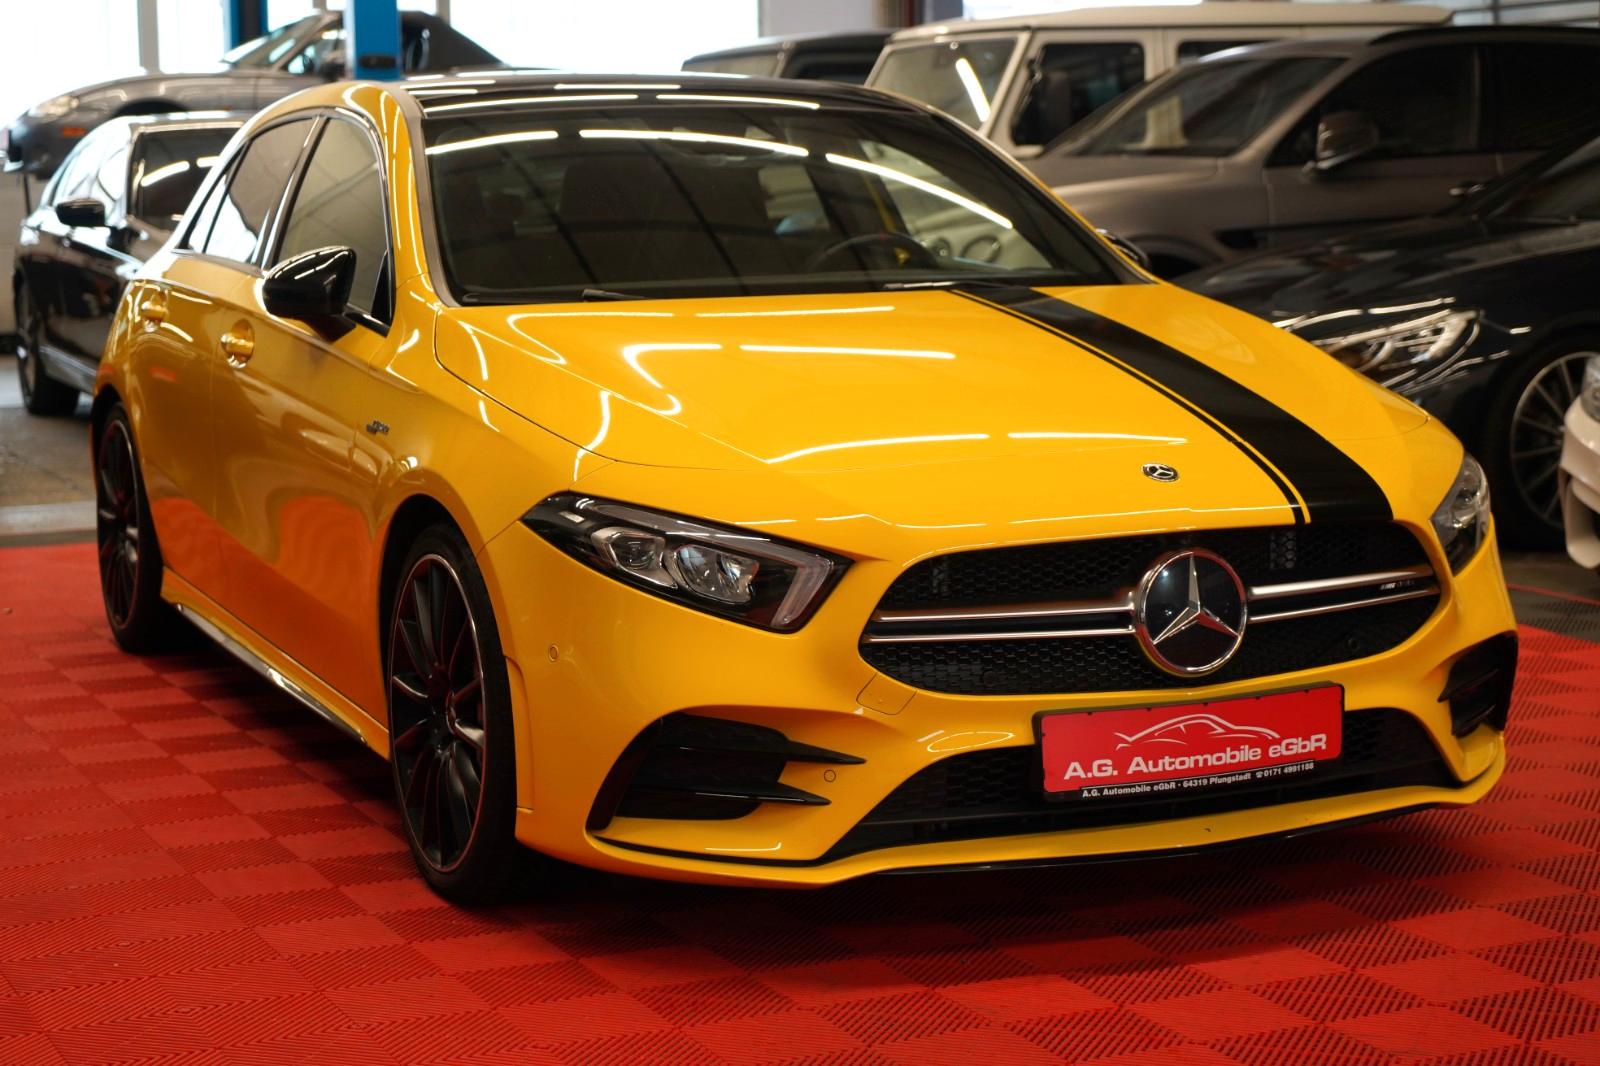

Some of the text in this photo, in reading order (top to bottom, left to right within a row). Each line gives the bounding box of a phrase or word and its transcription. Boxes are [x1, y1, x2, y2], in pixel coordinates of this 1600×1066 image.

[1064, 733, 1327, 780] A.G. Automobile eGbR
[1082, 788, 1101, 798] A.G.
[1103, 783, 1151, 796] Automobile
[1153, 783, 1176, 792] eGbR
[1182, 778, 1208, 788] 64319
[1209, 773, 1252, 785] Pfungstadt
[1264, 767, 1281, 777] 0171
